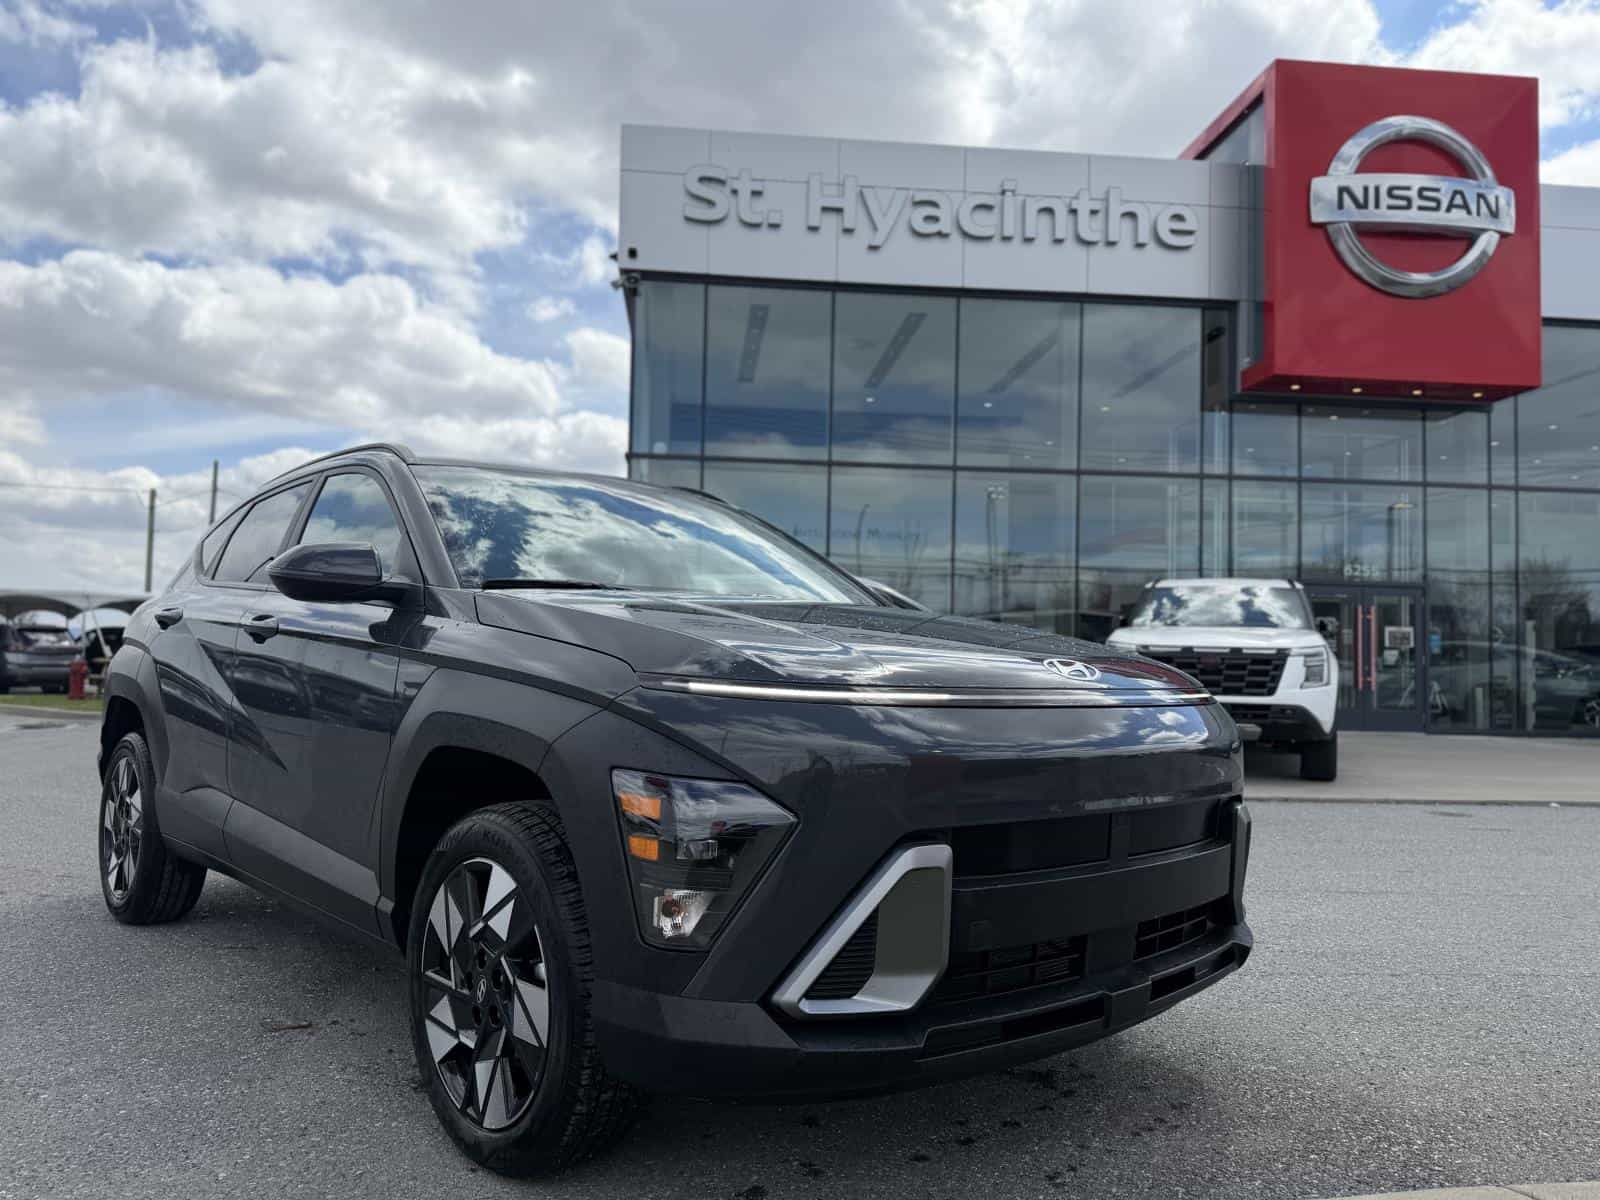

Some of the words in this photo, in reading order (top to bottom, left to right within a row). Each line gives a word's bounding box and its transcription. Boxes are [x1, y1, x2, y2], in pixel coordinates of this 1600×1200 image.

[682, 164, 782, 228] St.
[806, 172, 1199, 251] Hyacinthe
[1336, 184, 1500, 220] NISSAN
